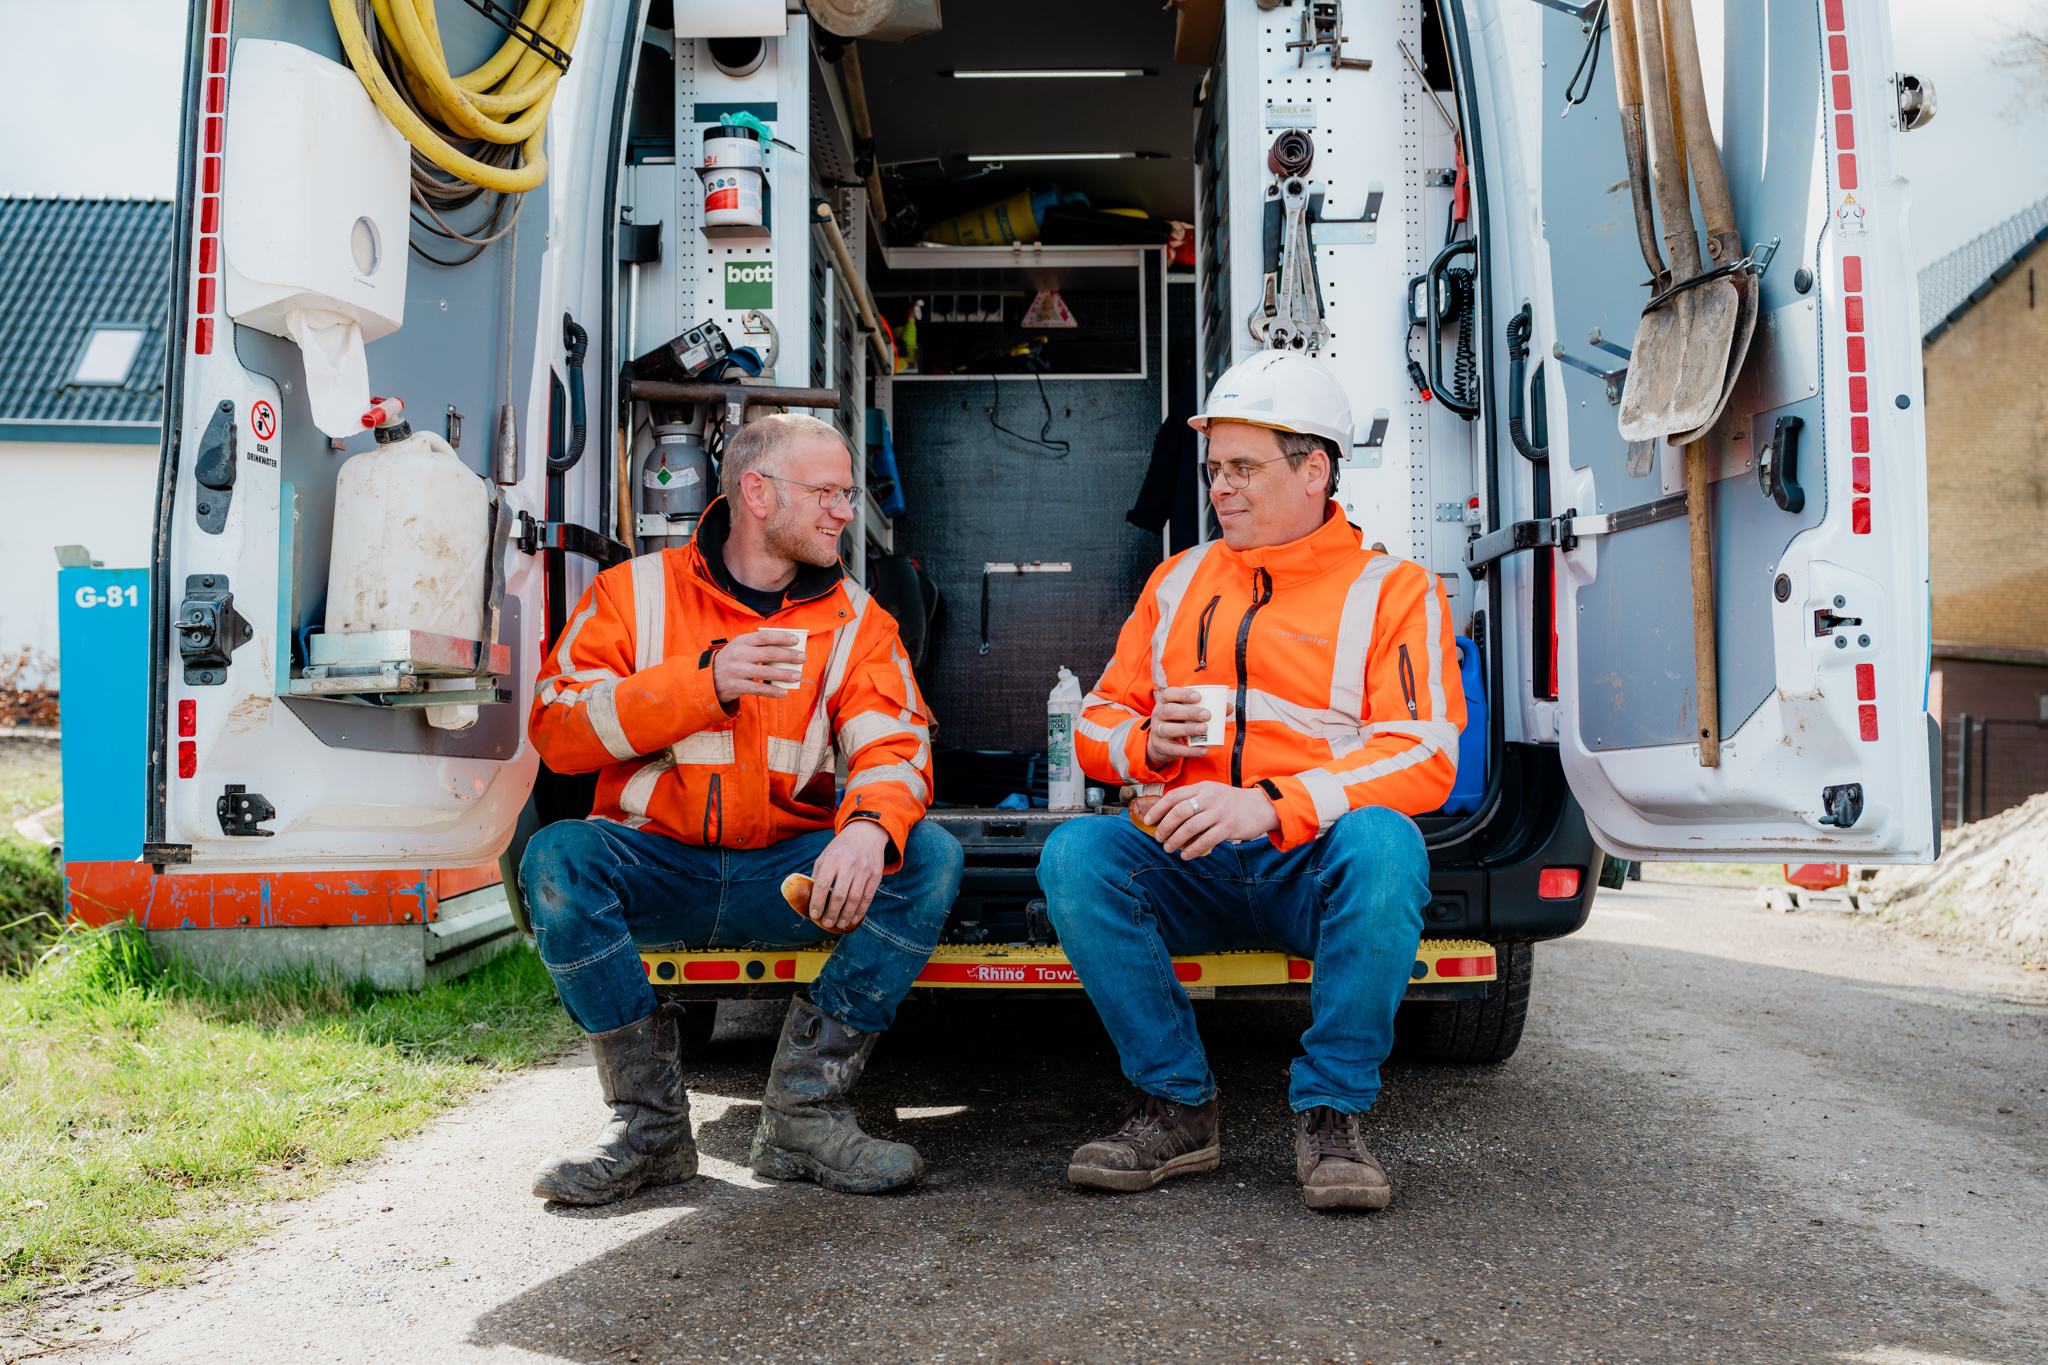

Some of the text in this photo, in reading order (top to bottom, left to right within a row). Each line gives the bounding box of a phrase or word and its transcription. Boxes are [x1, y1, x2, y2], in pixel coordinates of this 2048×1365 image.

[727, 265, 773, 284] bott
[256, 443, 269, 455] GEEN
[246, 451, 278, 468] DRINKWATER
[75, 584, 138, 608] G-81
[979, 967, 1025, 980] Rhino
